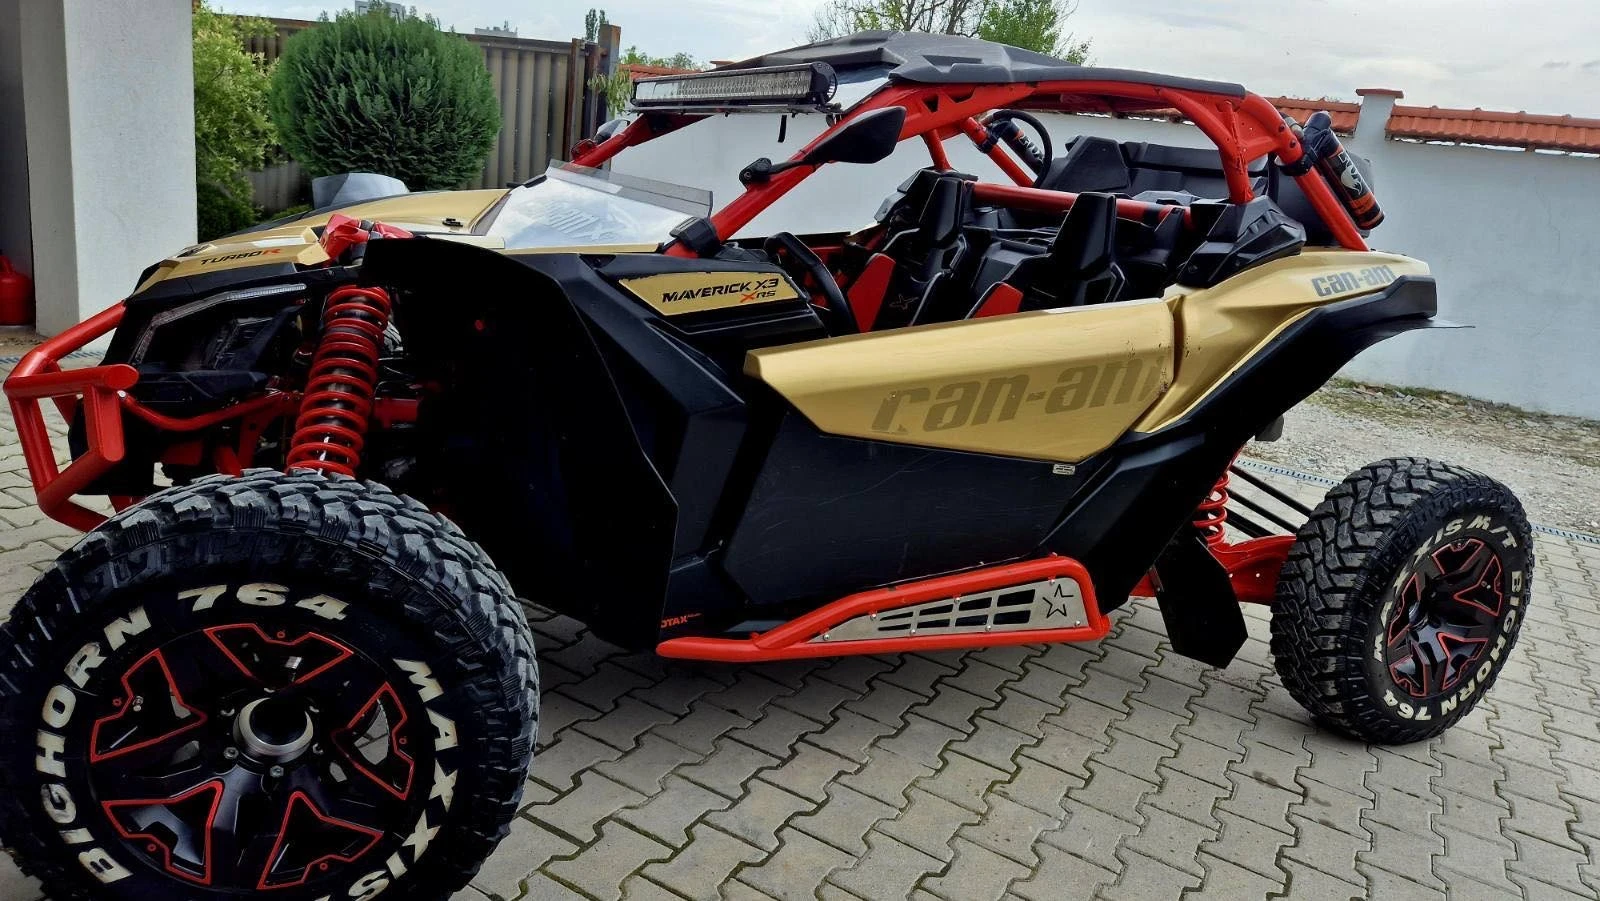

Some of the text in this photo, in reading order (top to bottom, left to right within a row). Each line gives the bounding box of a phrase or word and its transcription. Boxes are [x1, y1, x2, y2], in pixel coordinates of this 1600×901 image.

[662, 278, 779, 303] MAVERICK X3
[1312, 265, 1396, 297] can-am
[1374, 514, 1518, 663] MAXXIS M/T
[1383, 570, 1523, 720] BIGHORN 764
[35, 583, 349, 884] BIGHORN 764
[348, 658, 459, 901] MAXXIS
